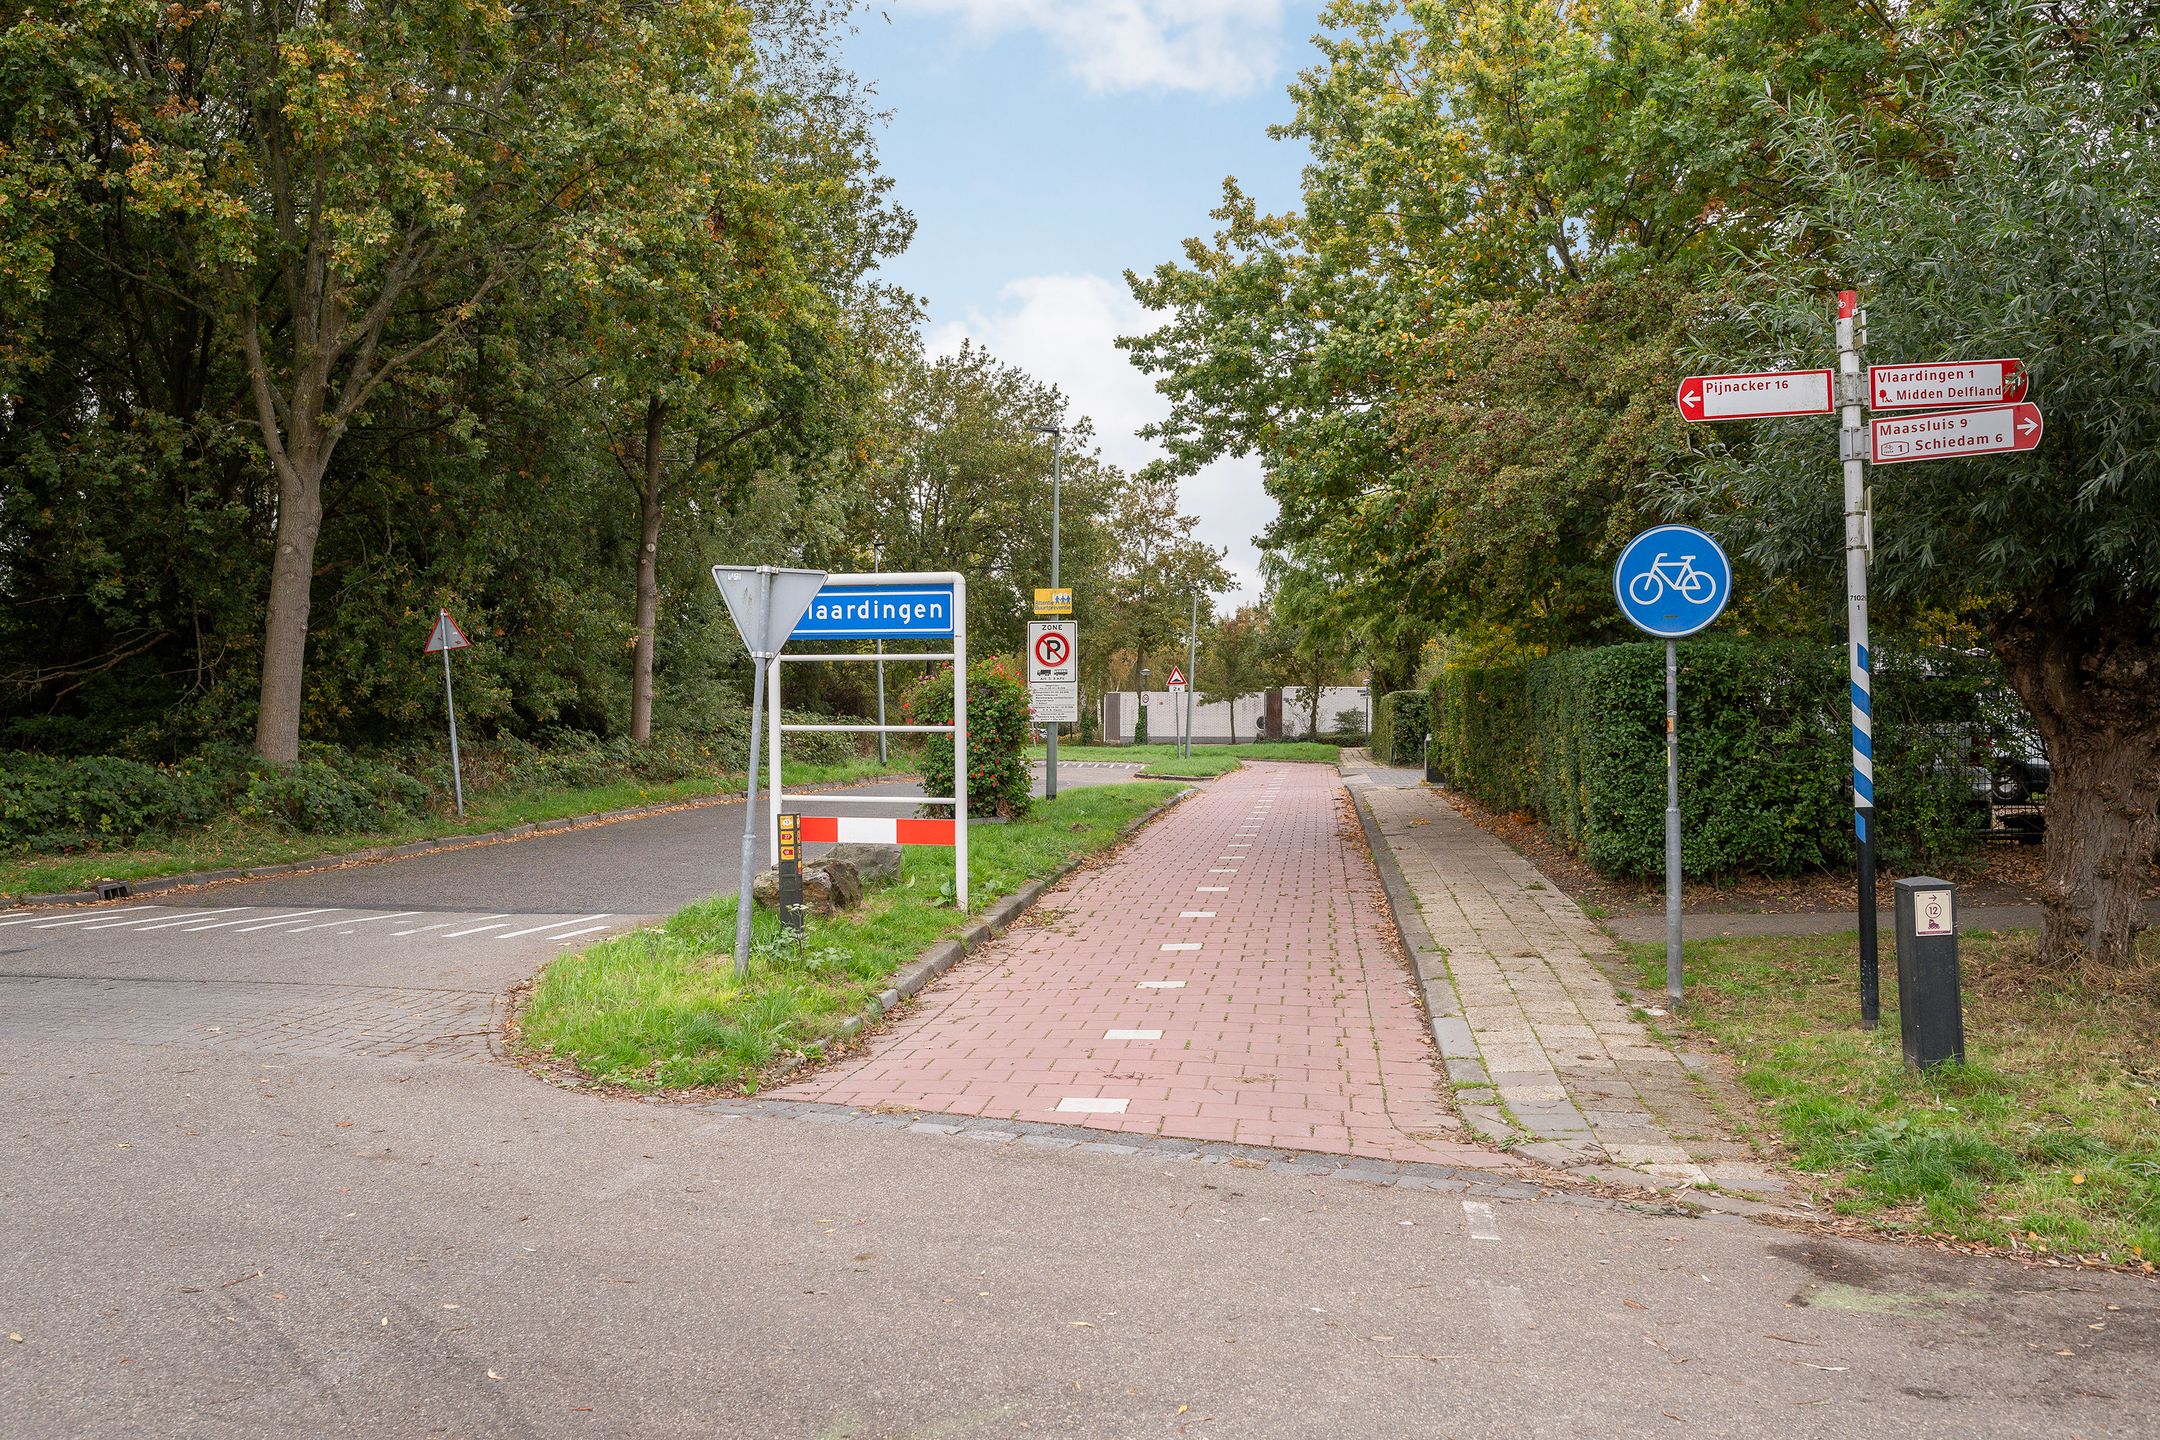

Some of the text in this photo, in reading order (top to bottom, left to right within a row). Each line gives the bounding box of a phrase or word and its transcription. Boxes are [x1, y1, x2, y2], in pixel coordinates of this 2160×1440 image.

[1877, 369, 1975, 383] Vlaardingen 1
[1706, 379, 1789, 396] Pijnacker 16
[1896, 384, 2002, 401] Midden Delfland
[1880, 418, 1968, 436] Maassluis 9
[1898, 444, 1903, 452] 1
[1915, 433, 2003, 451] Schiedam 6
[808, 600, 943, 624] laardingen
[1929, 907, 1938, 915] 12
